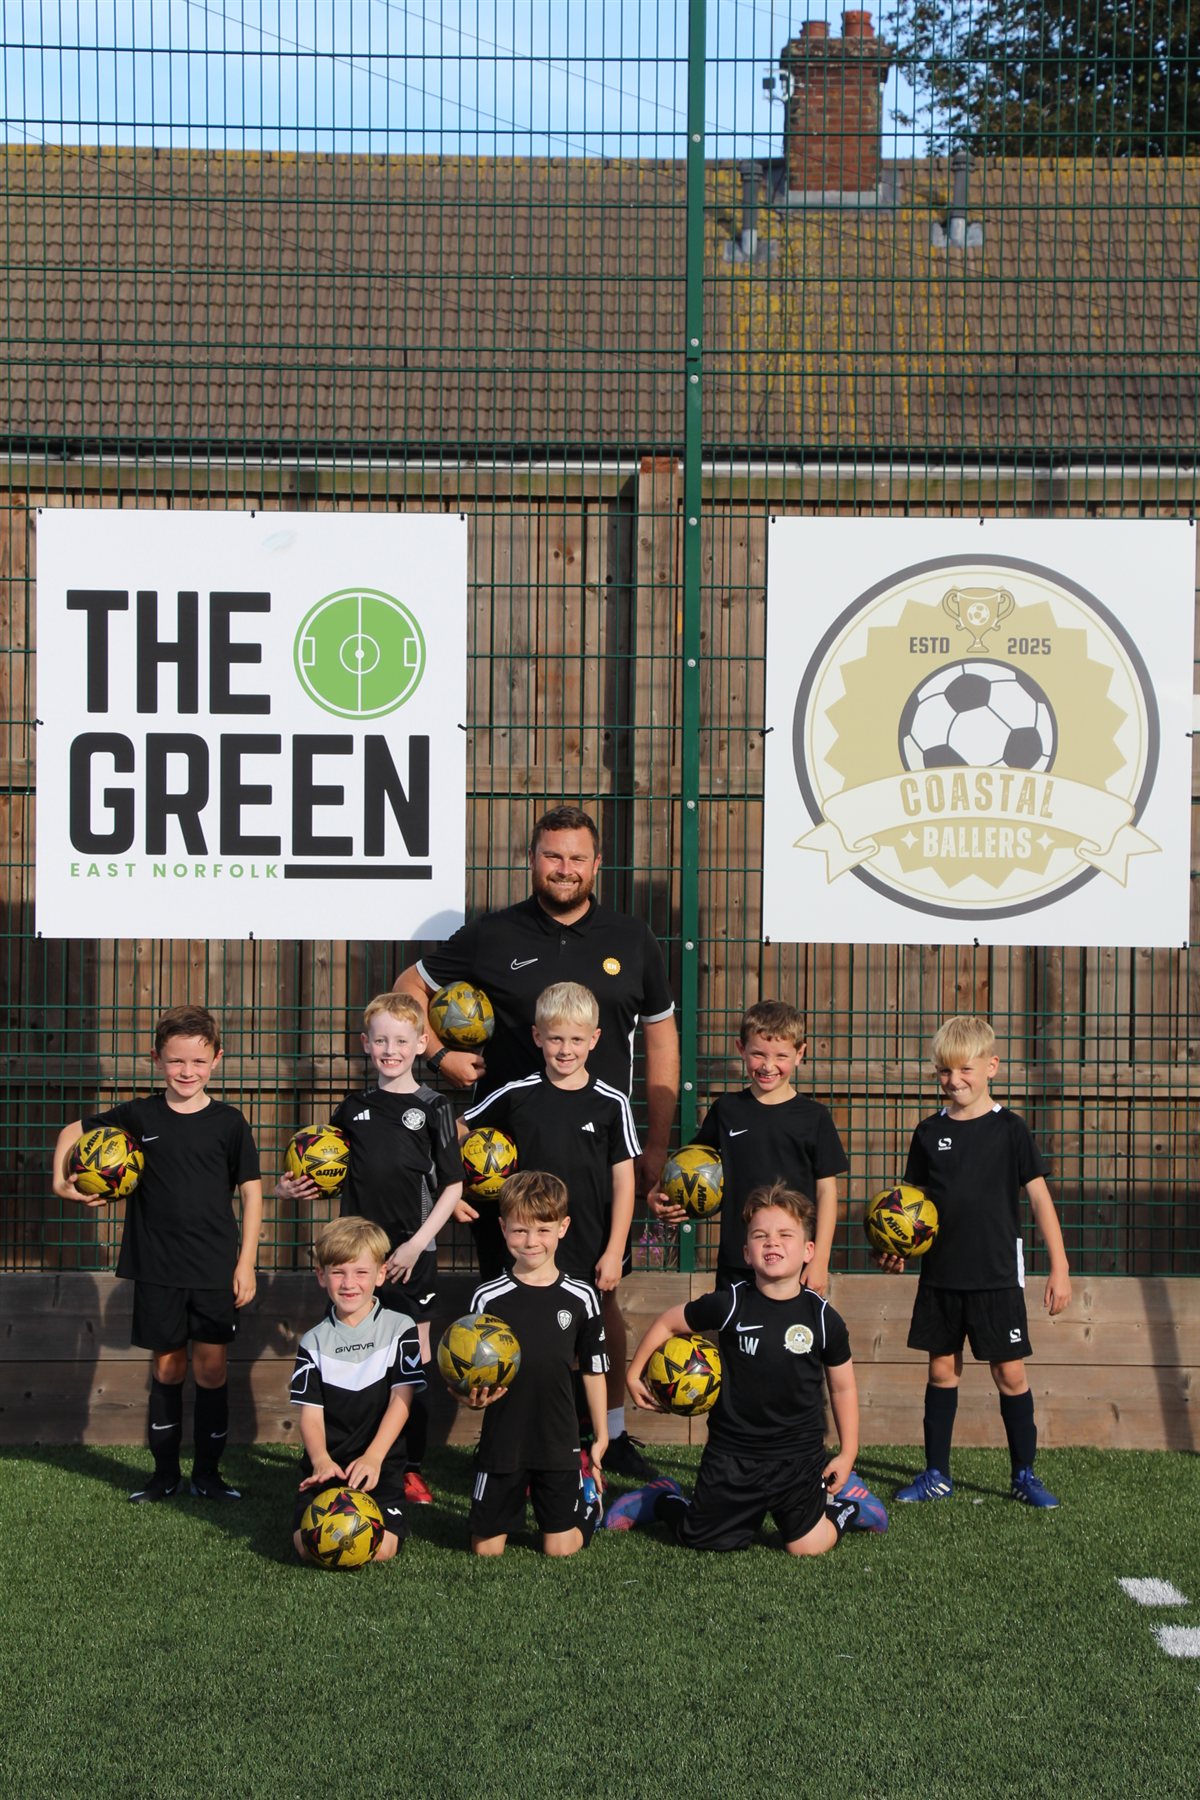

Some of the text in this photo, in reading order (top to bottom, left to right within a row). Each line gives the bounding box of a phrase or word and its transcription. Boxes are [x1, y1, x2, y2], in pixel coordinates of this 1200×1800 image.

[67, 589, 271, 715] THE
[909, 636, 1052, 655] ESTD 2025
[69, 732, 430, 857] GREEN
[899, 772, 1055, 819] COASTAL
[923, 825, 1032, 859] BALLERS
[70, 862, 279, 879] EAST NORFOLK
[315, 1167, 346, 1178] Mitre
[883, 1215, 909, 1241] Mitre
[335, 1342, 375, 1354] GIVOVA
[739, 1335, 760, 1355] LW
